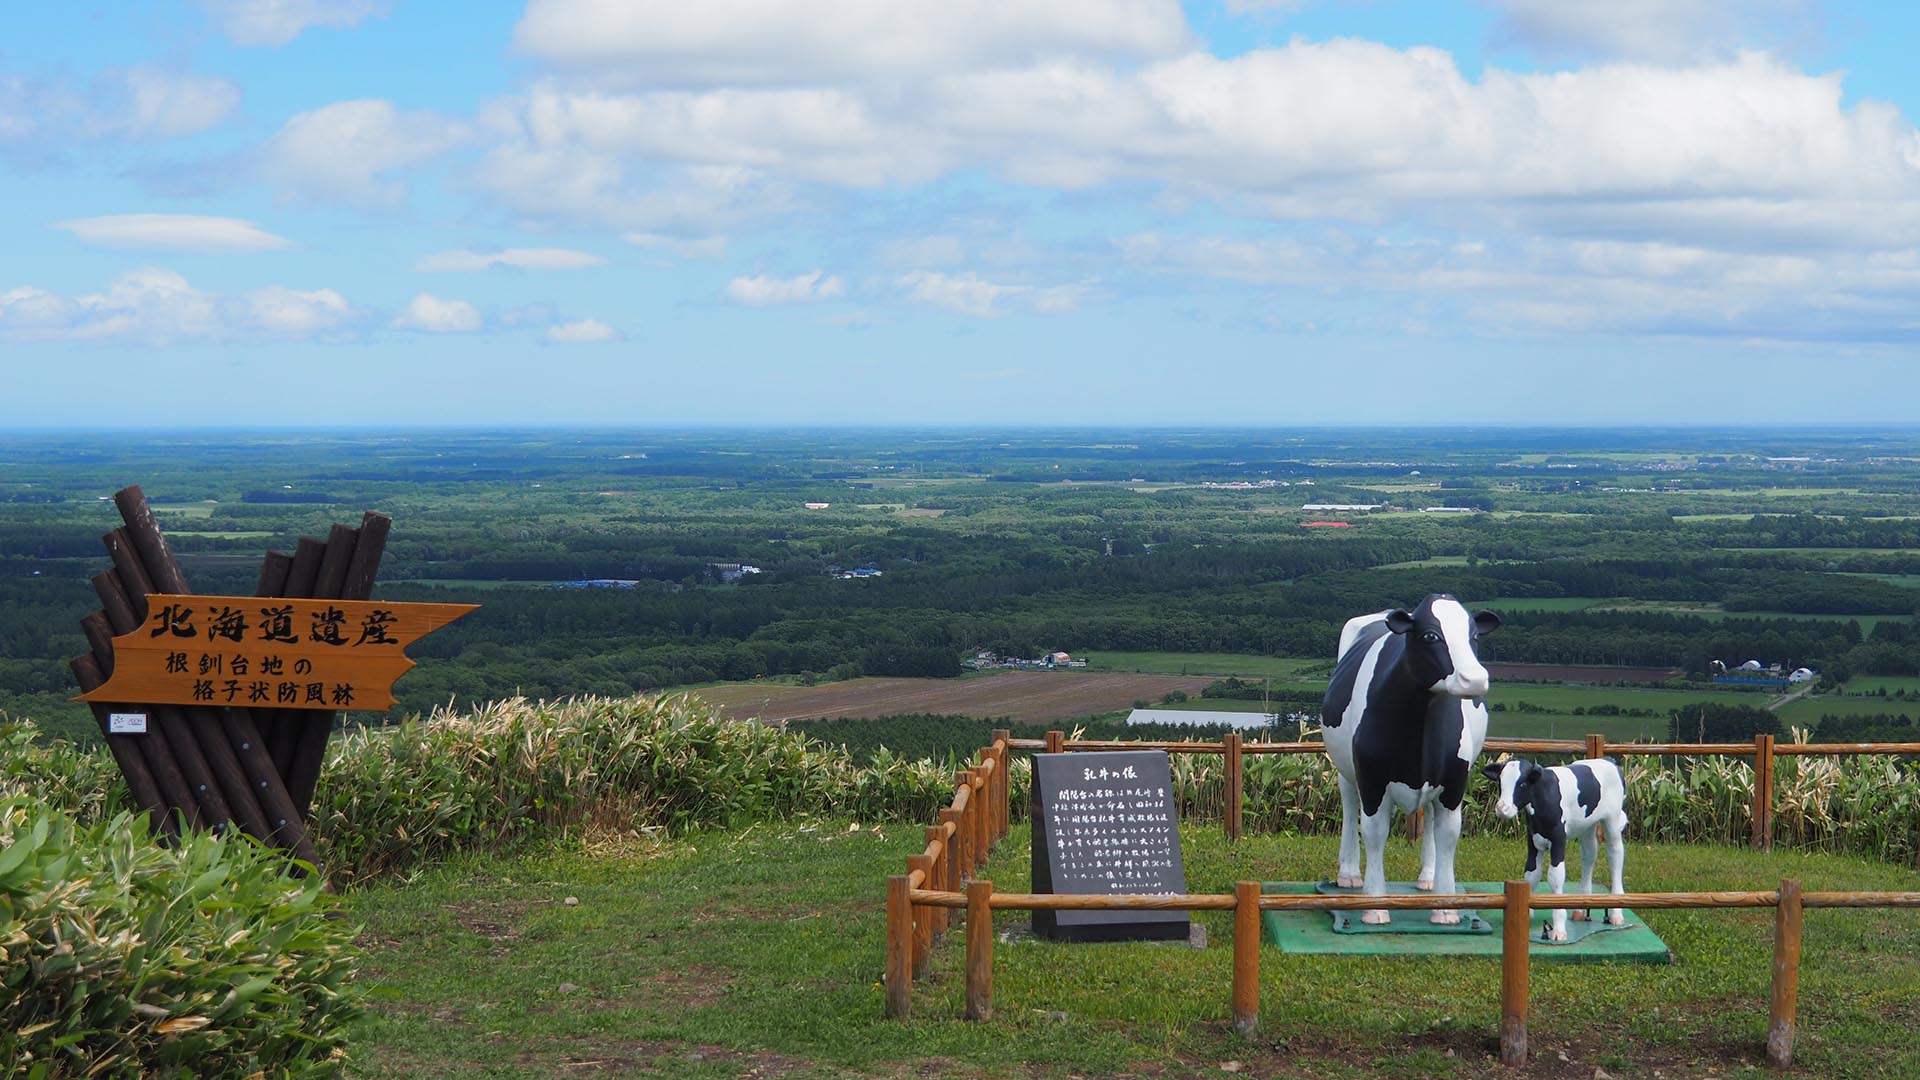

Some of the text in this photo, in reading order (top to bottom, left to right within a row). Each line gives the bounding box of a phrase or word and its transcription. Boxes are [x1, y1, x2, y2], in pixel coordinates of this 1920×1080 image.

[151, 603, 400, 647] 北海道遺産
[165, 651, 313, 676] 根釧台地の
[193, 679, 355, 707] 格子状防風林
[1084, 765, 1138, 781] 乳牛の像
